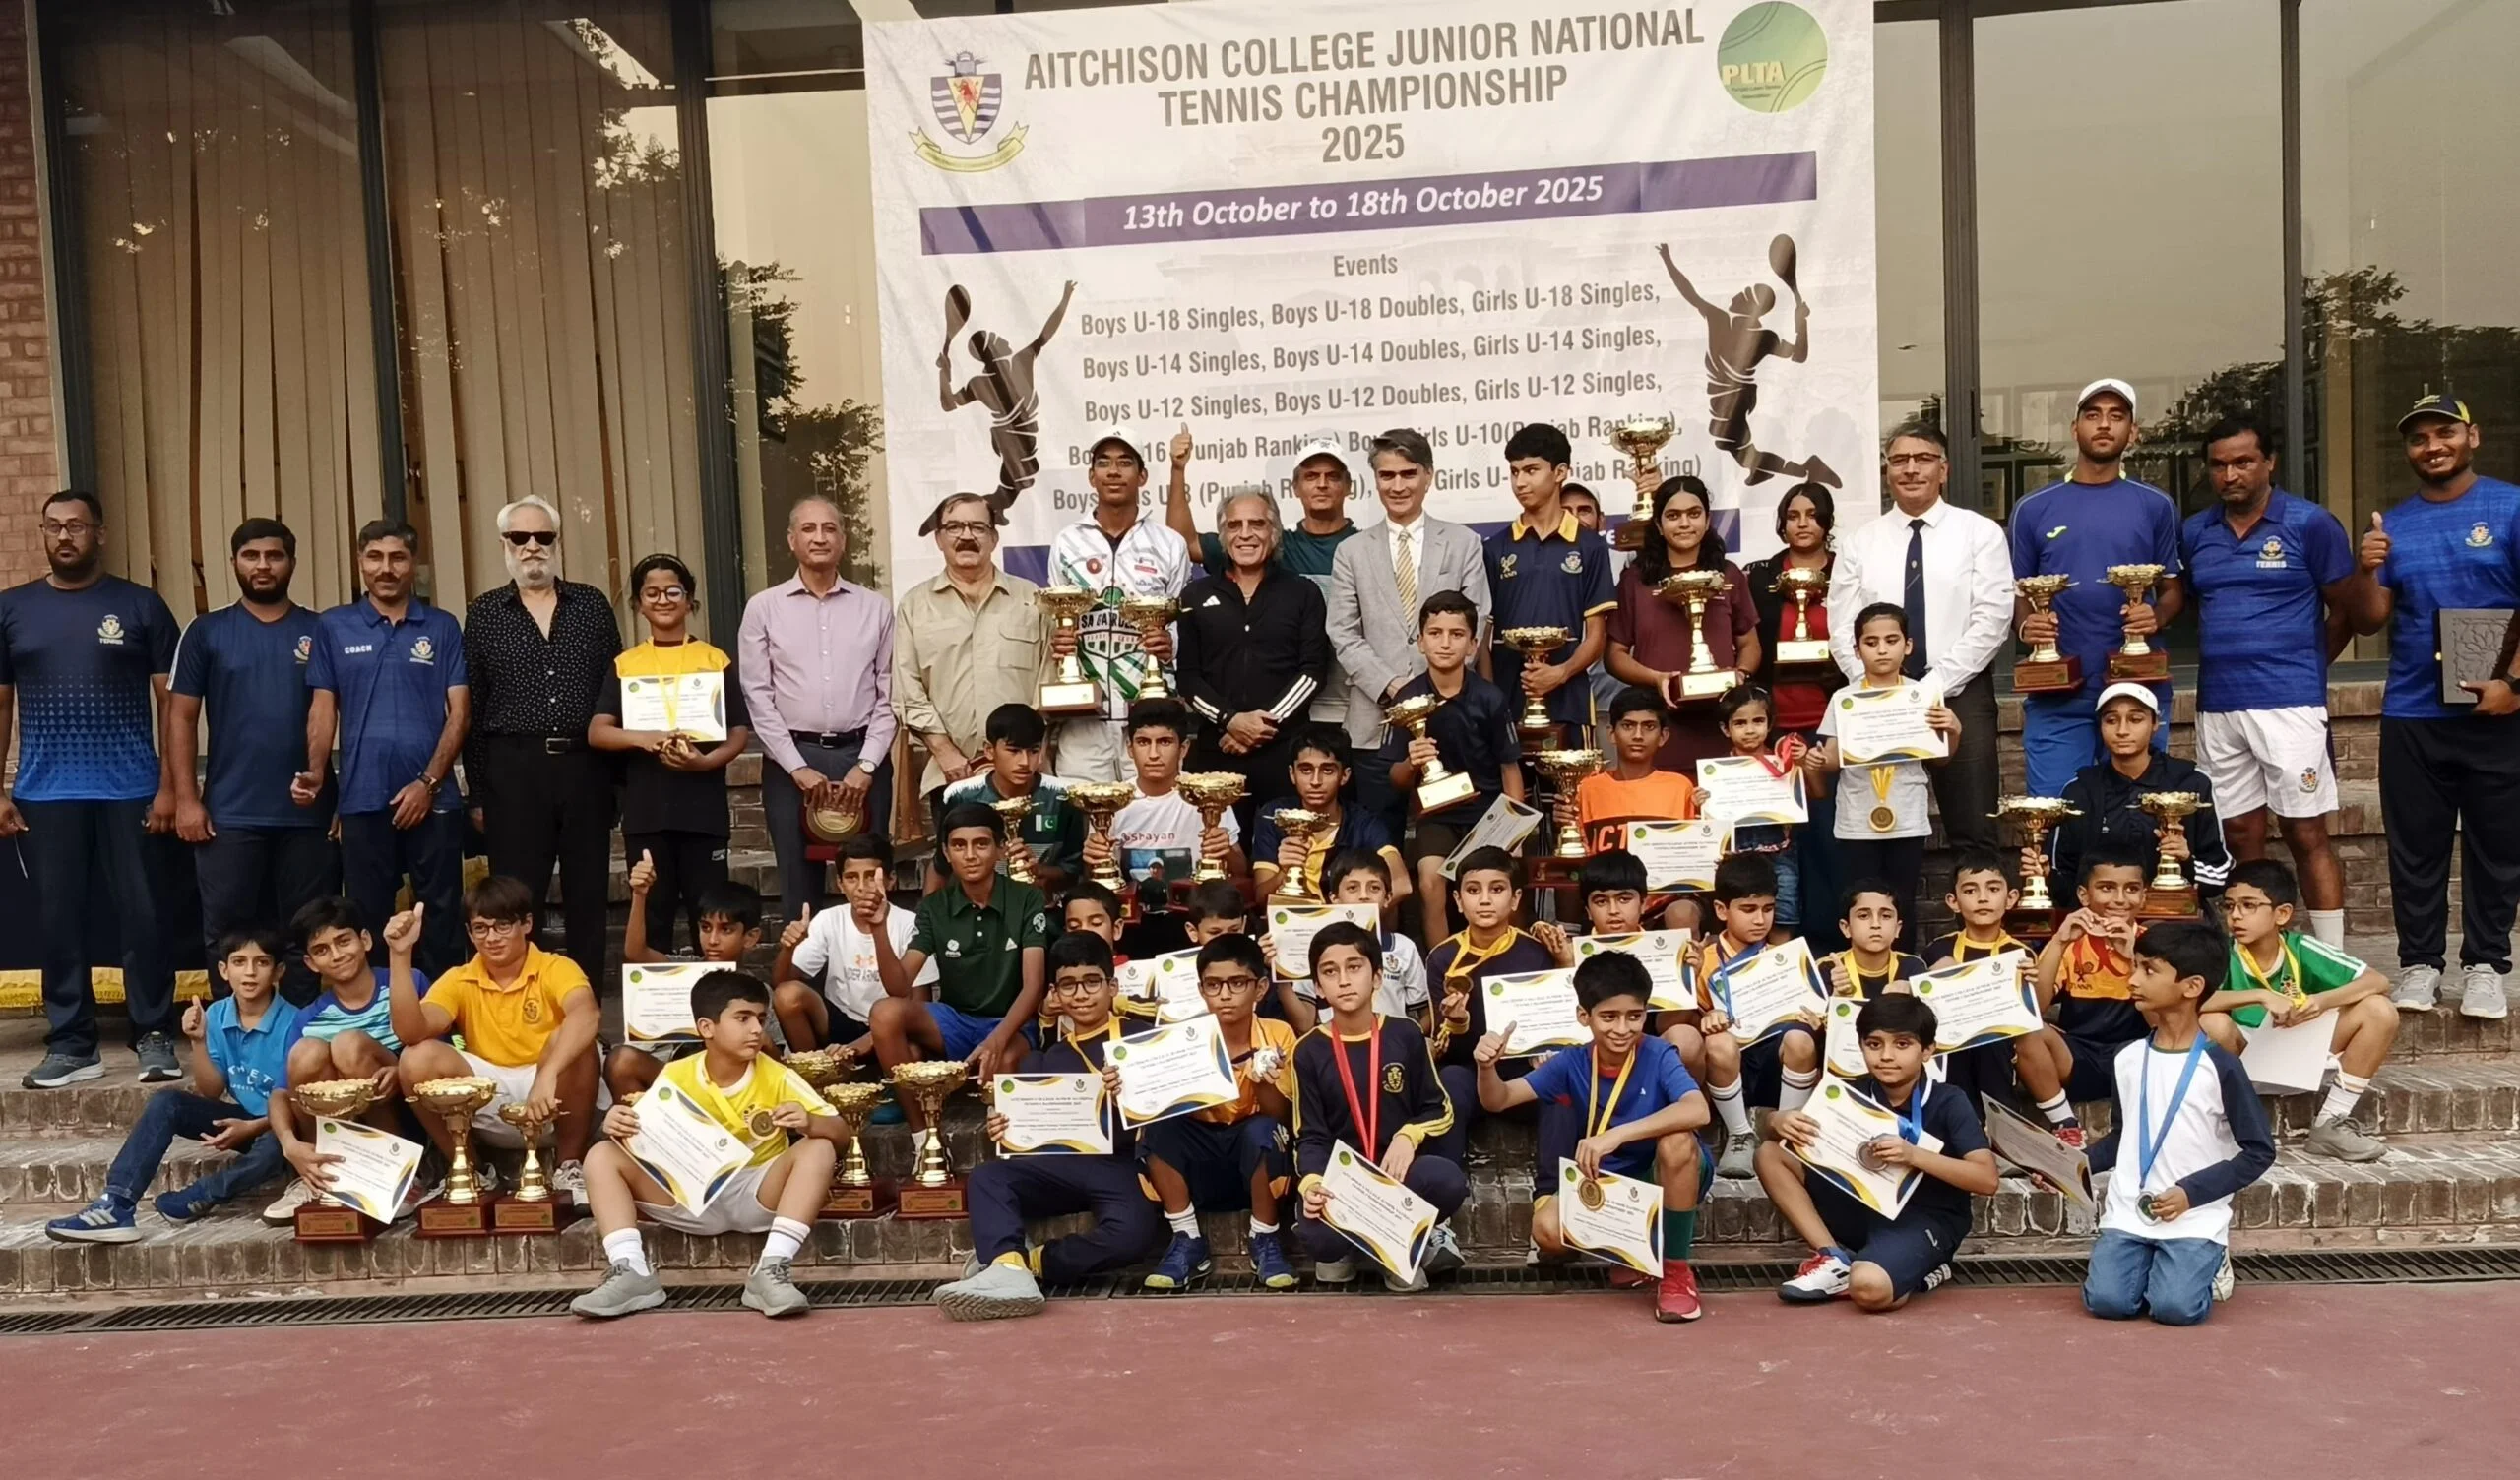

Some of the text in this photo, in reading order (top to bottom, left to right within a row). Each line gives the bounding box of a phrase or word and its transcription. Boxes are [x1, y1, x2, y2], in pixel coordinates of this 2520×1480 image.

[1025, 8, 1705, 89] AITCHISON COLLEGE JUNIOR NATIONAL
[1158, 65, 1567, 127] TENNIS CHAMPIONSHIP
[1723, 61, 1786, 86] PLTA
[1322, 123, 1405, 163] 2025
[1123, 176, 1603, 230] 13th October to 18th October 2025
[1334, 254, 1397, 277] Events
[1082, 281, 1660, 338] Boys U-18 Singles, Boys U-18 Doubles, Girls U-18 Singles,
[1084, 326, 1661, 382] Boys U-14 Singles, Boys U-14 Doubles, Girls U-14 Singles,
[1086, 370, 1661, 425] Boys U-12 Singles, Boys U-12 Doubles, Girls U-12 Singles,
[1069, 445, 1093, 466] Bo
[1195, 437, 1248, 463] unjab
[1435, 468, 1480, 490] Girls
[1487, 466, 1509, 487] U-
[345, 645, 372, 654] COACH
